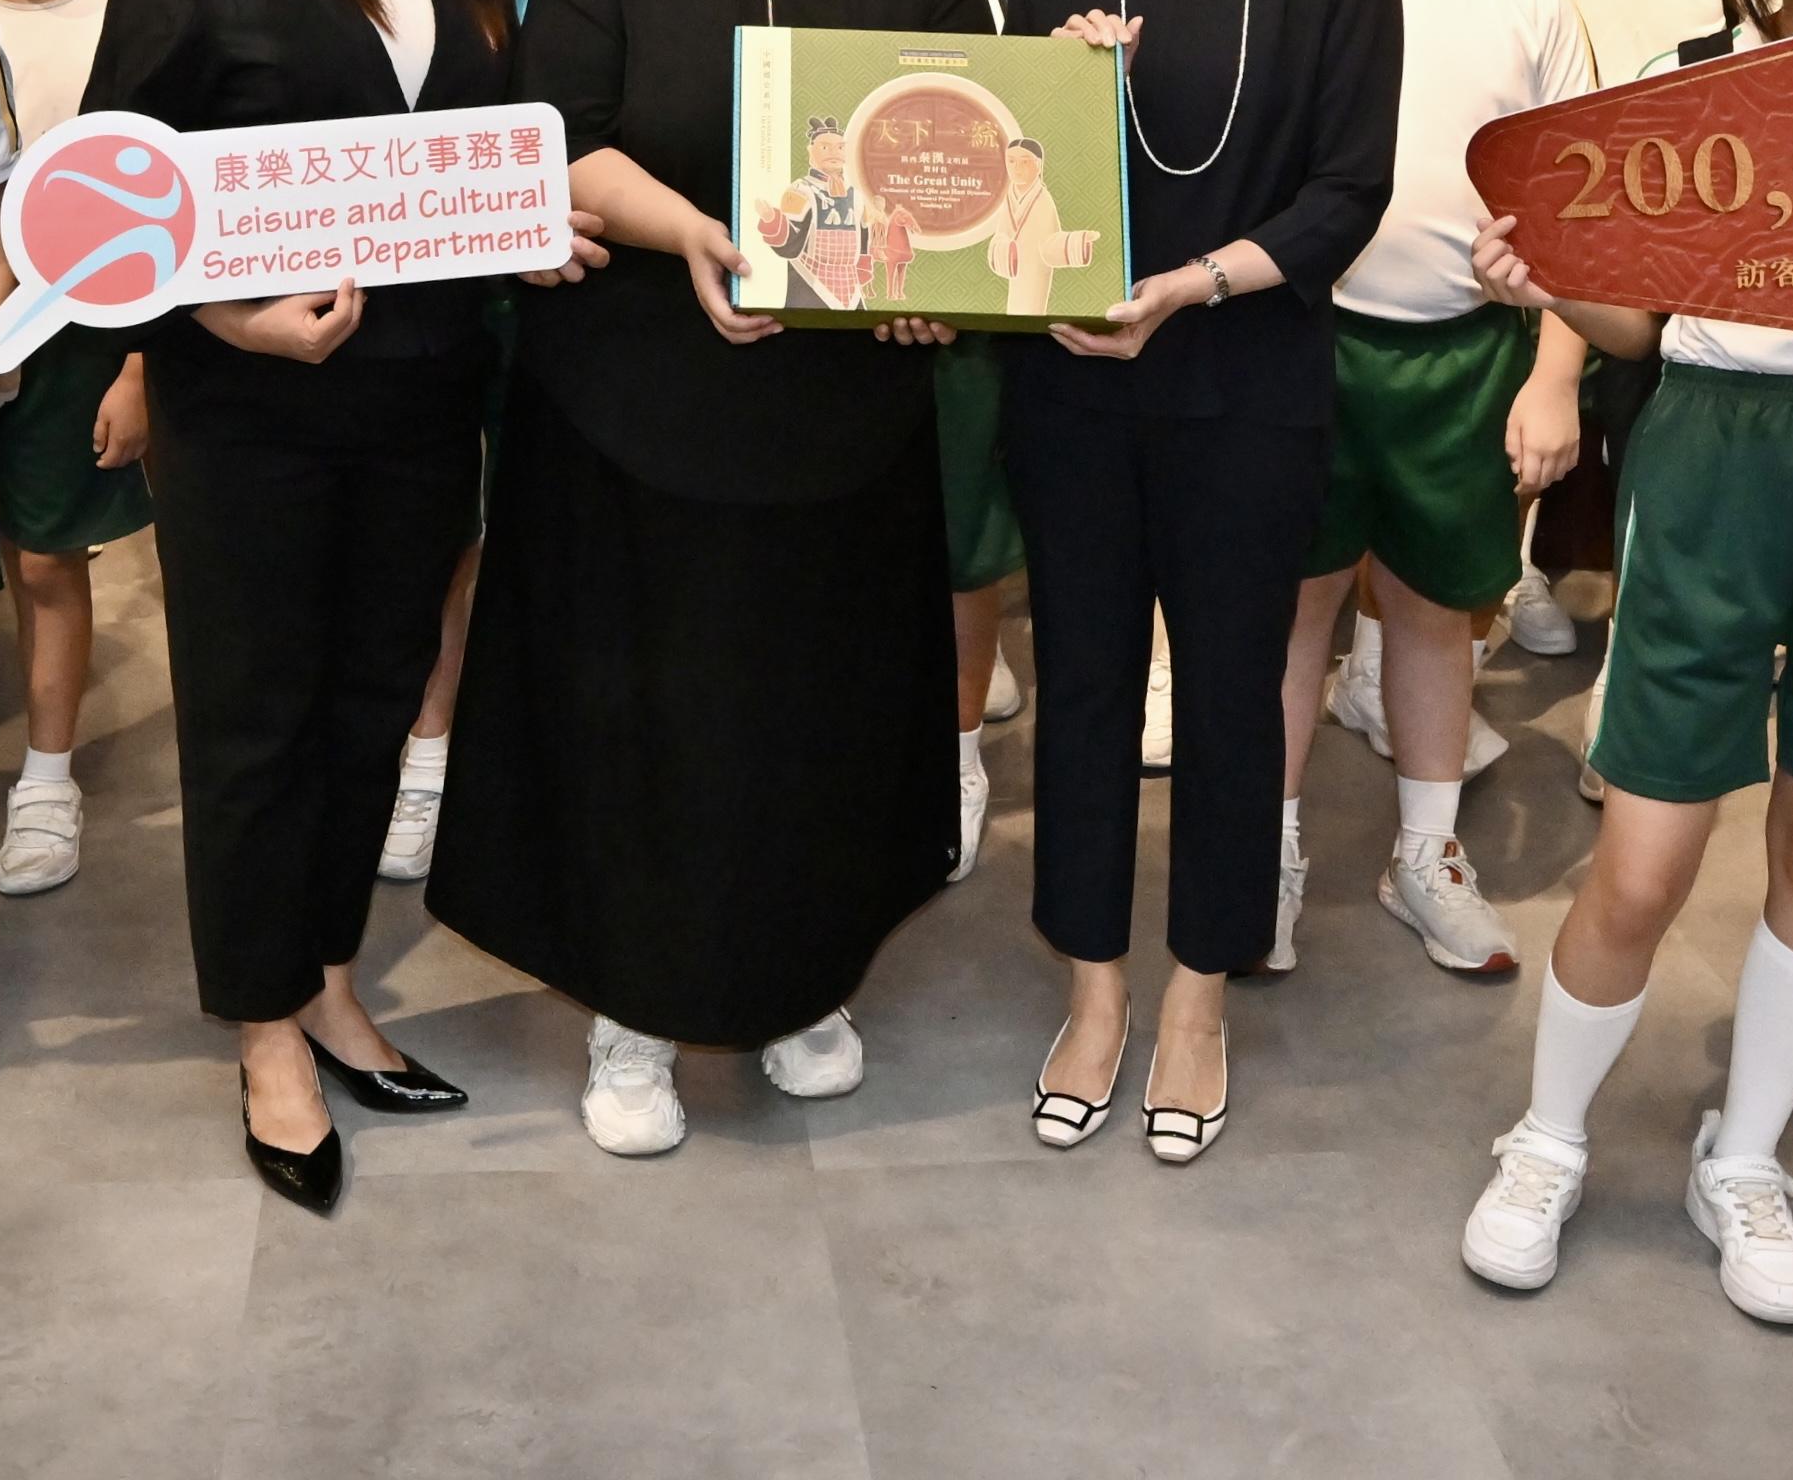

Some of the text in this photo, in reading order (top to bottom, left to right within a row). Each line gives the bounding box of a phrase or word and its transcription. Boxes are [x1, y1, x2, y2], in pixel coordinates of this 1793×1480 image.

[213, 126, 544, 193] 康樂及文化事務署
[870, 117, 1000, 150] 天下一統
[217, 179, 548, 238] Leisure and Cultural
[888, 174, 983, 190] The Great Unity
[202, 222, 552, 280] Services Department
